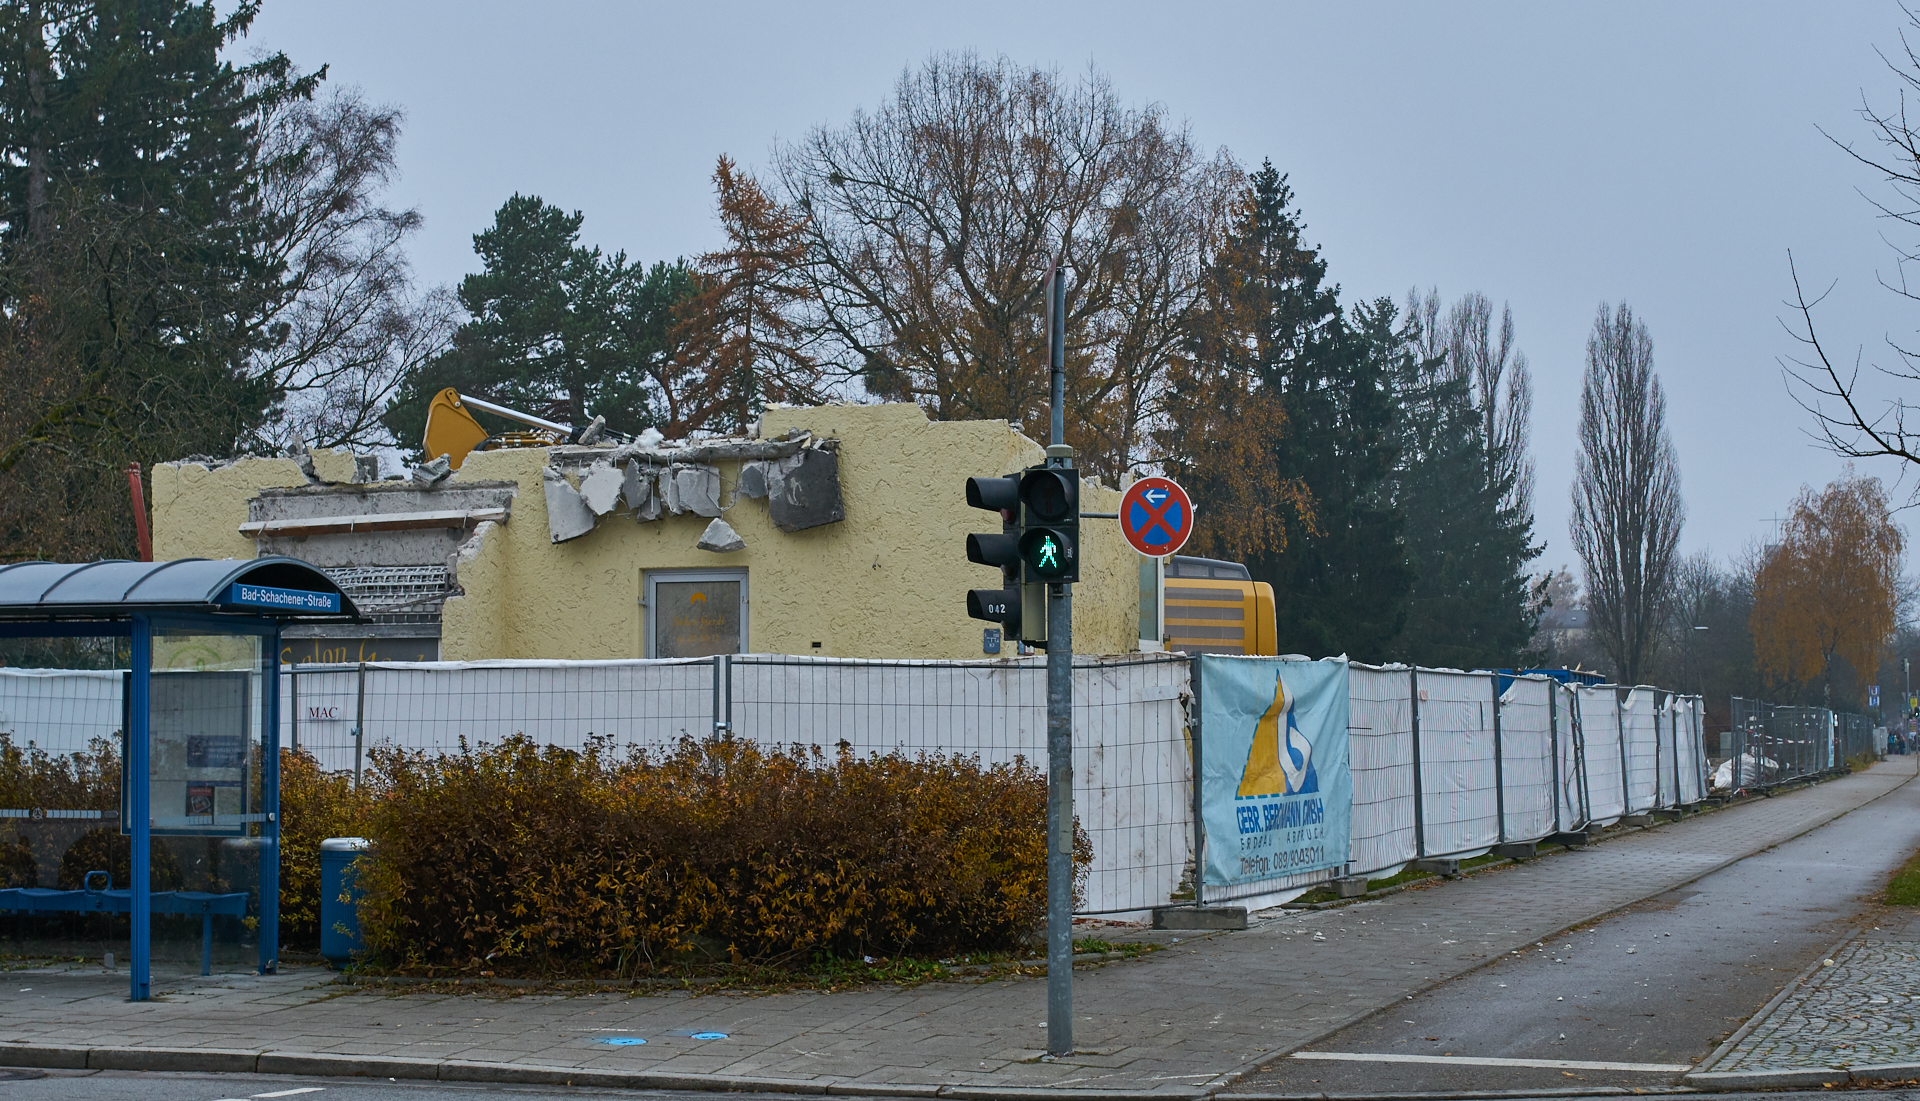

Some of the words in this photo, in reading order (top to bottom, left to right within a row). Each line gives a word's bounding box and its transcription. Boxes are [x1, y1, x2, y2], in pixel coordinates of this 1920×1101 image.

[241, 587, 332, 608] Bad-Schachener-Straße
[988, 603, 1006, 614] 042
[671, 615, 698, 627] Salon
[308, 707, 338, 718] MAC
[1236, 806, 1264, 835] GEBR.
[1240, 855, 1271, 875] Telefon:
[1273, 845, 1324, 870] 089/9043011
